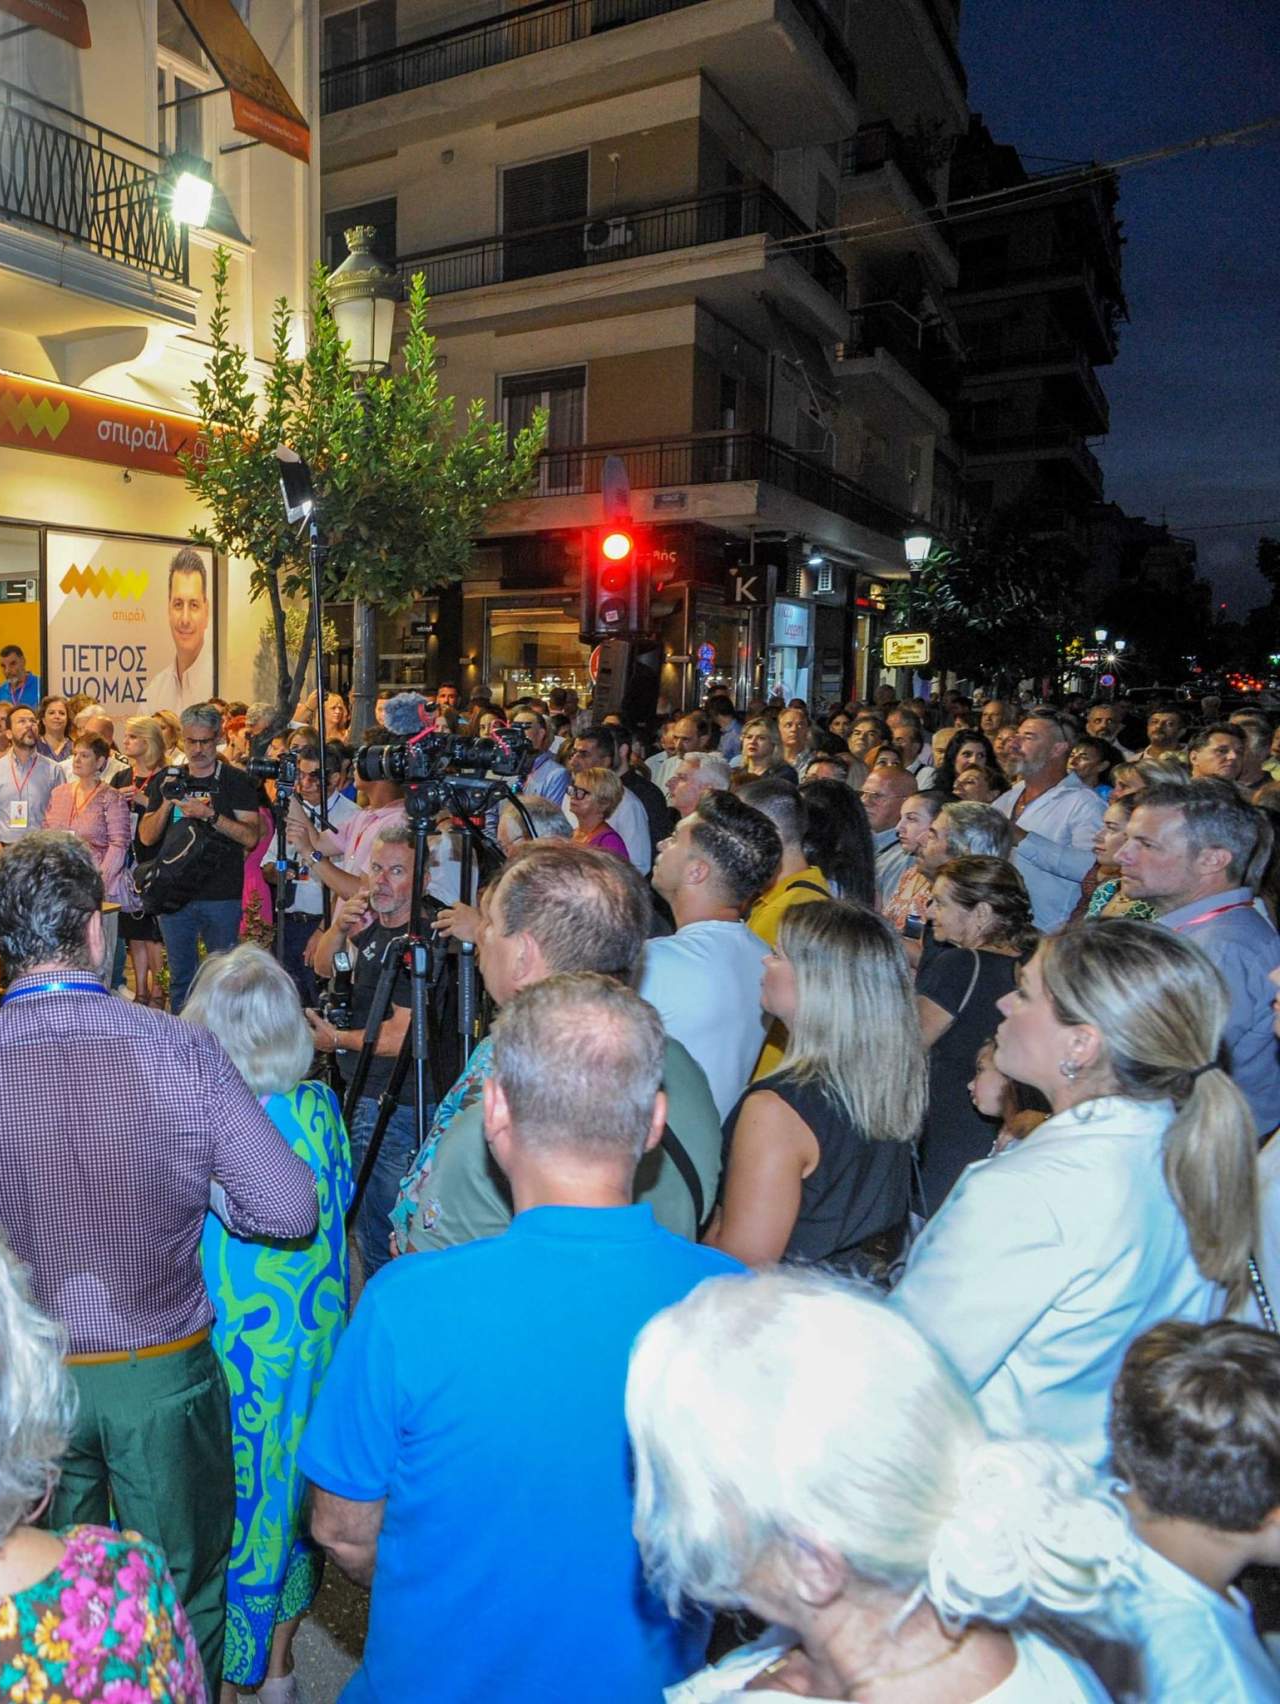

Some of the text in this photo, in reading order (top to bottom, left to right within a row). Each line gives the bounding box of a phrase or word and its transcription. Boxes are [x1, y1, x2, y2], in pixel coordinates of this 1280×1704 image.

[97, 419, 169, 453] σπιράλ
[61, 644, 148, 673] ΠΕΤΡΟΣ
[61, 676, 148, 704] ΨΩΜΑΣ
